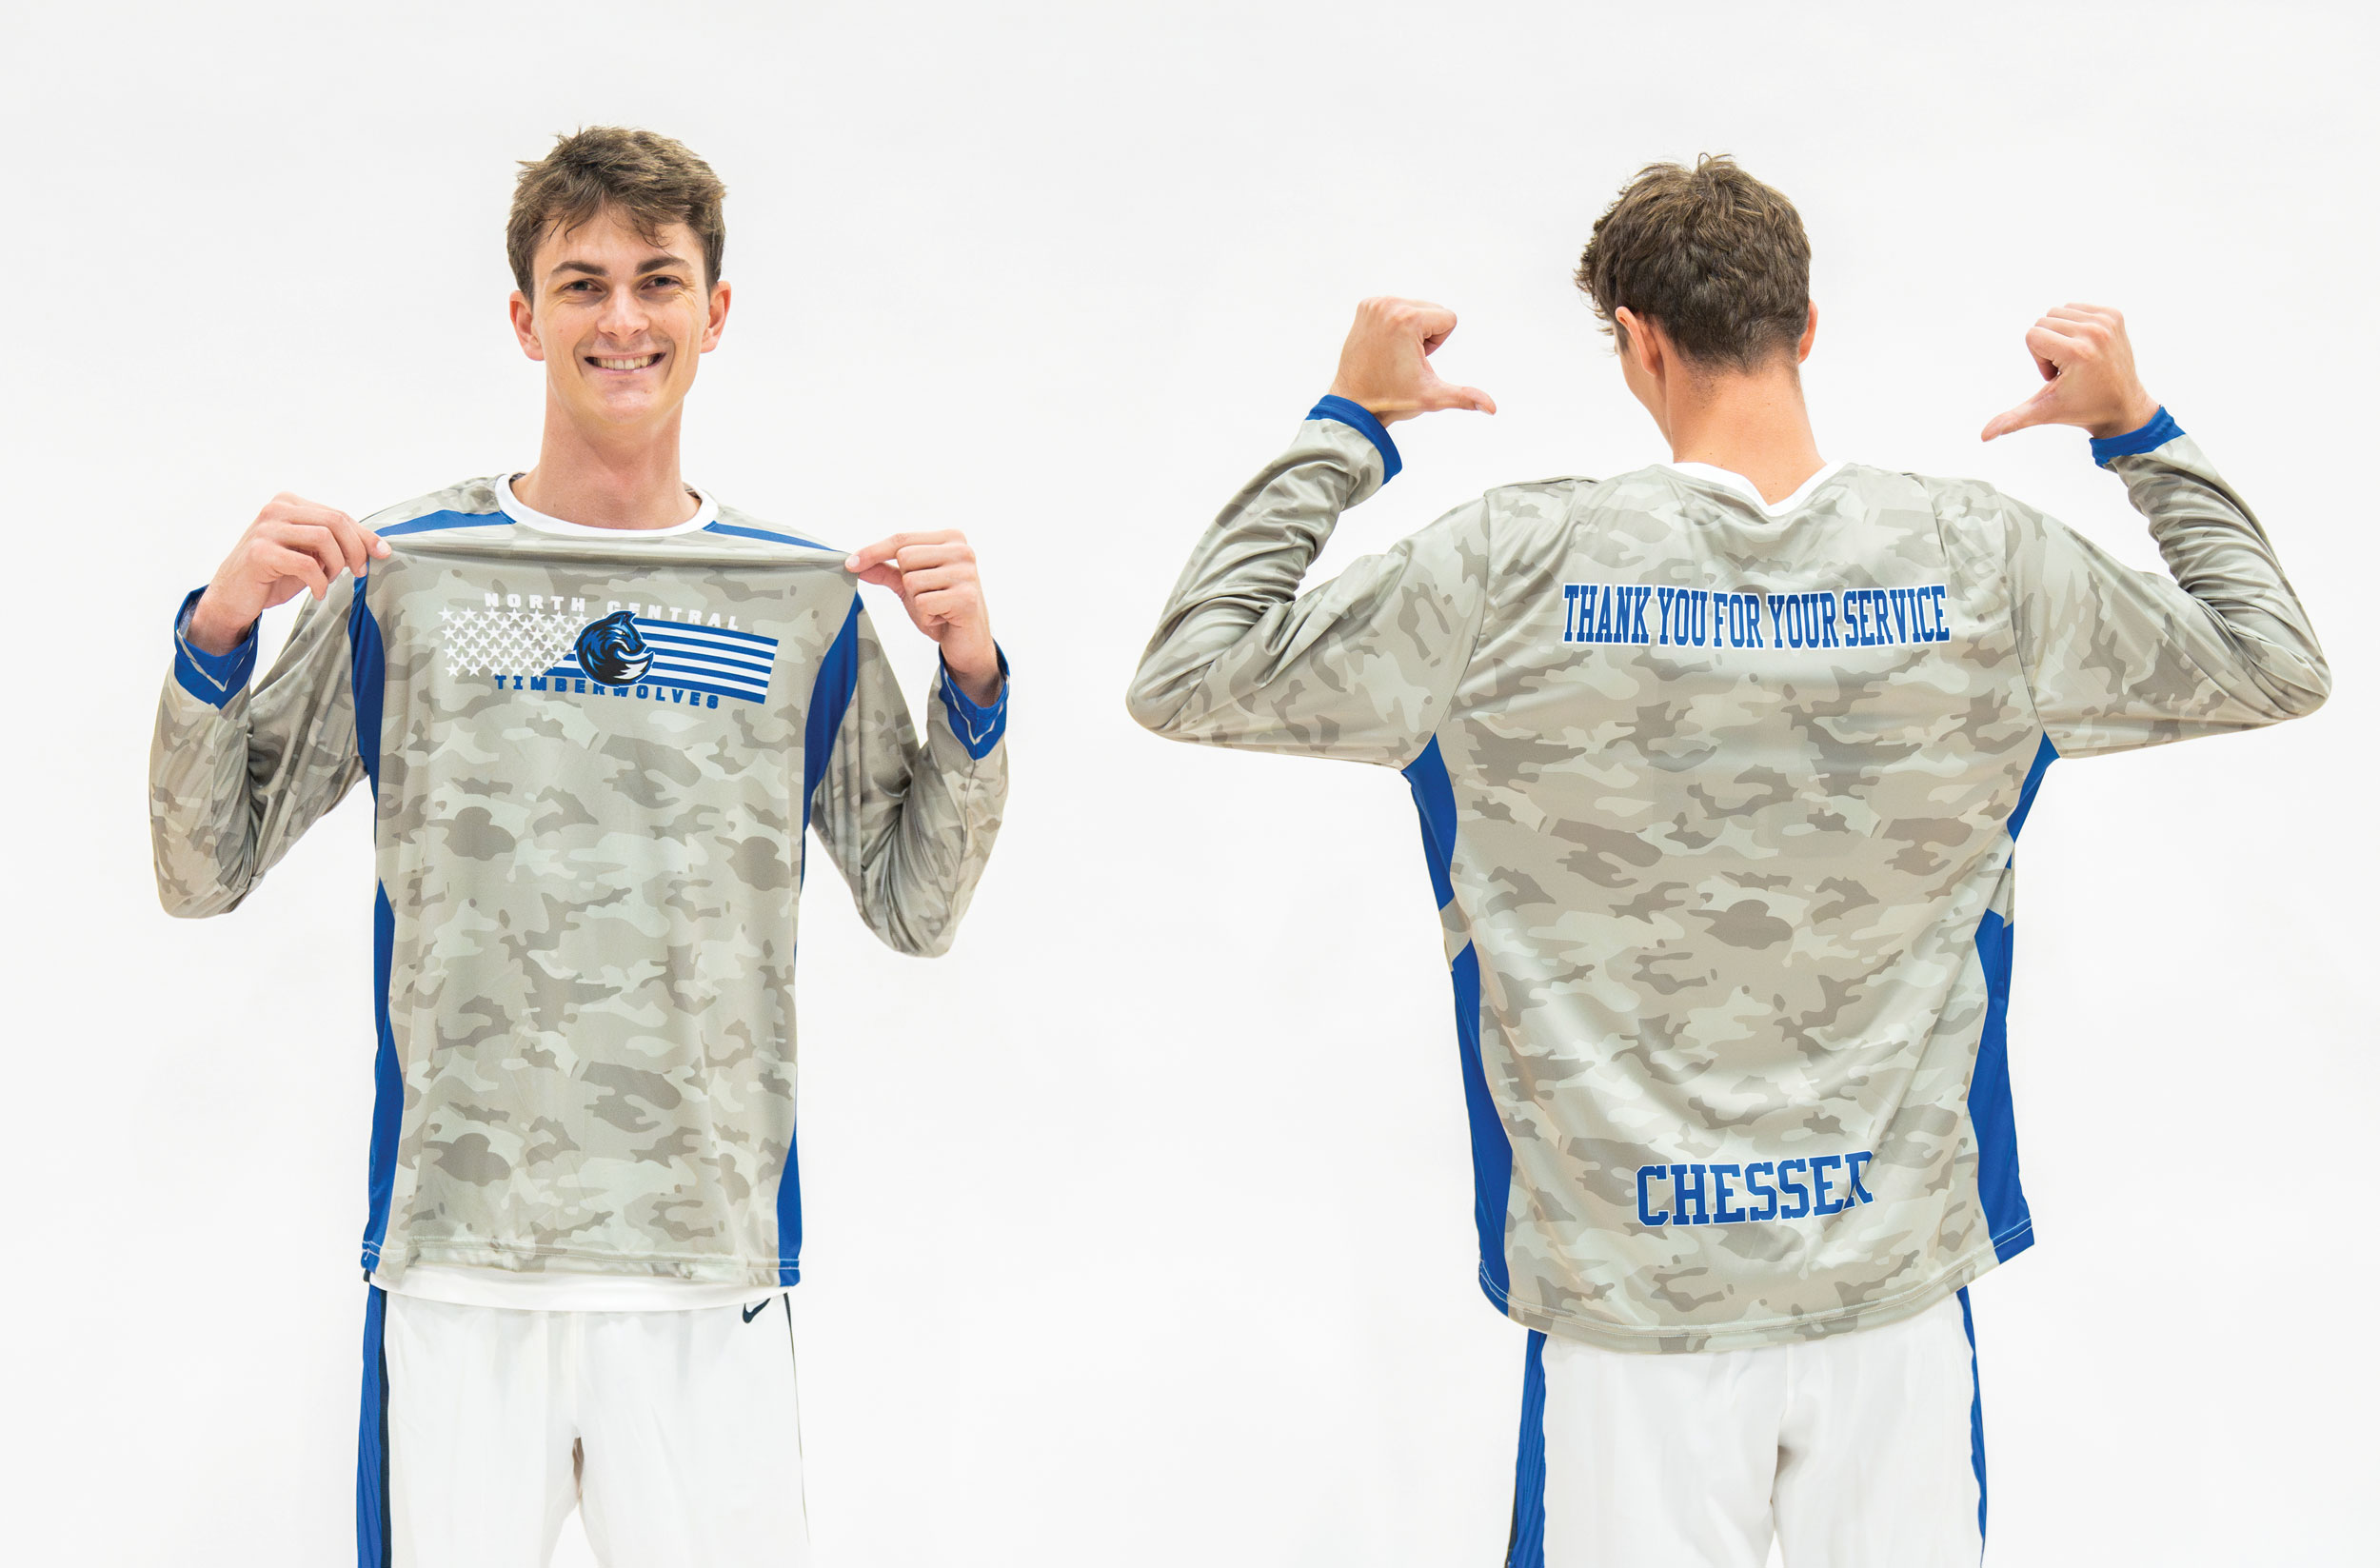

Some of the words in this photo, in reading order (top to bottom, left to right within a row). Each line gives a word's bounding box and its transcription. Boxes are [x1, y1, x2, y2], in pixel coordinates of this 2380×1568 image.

[484, 592, 585, 612] NORTH
[606, 600, 739, 630] CENTRAL
[1562, 584, 1652, 646] THANK
[1656, 585, 1711, 648] YOU
[1712, 590, 1765, 650] FOR
[1766, 590, 1840, 650] YOUR
[1841, 584, 1951, 647] SERVICE
[494, 675, 719, 709] TIMBERWOLVES
[1636, 1150, 1874, 1226] CHESSER
